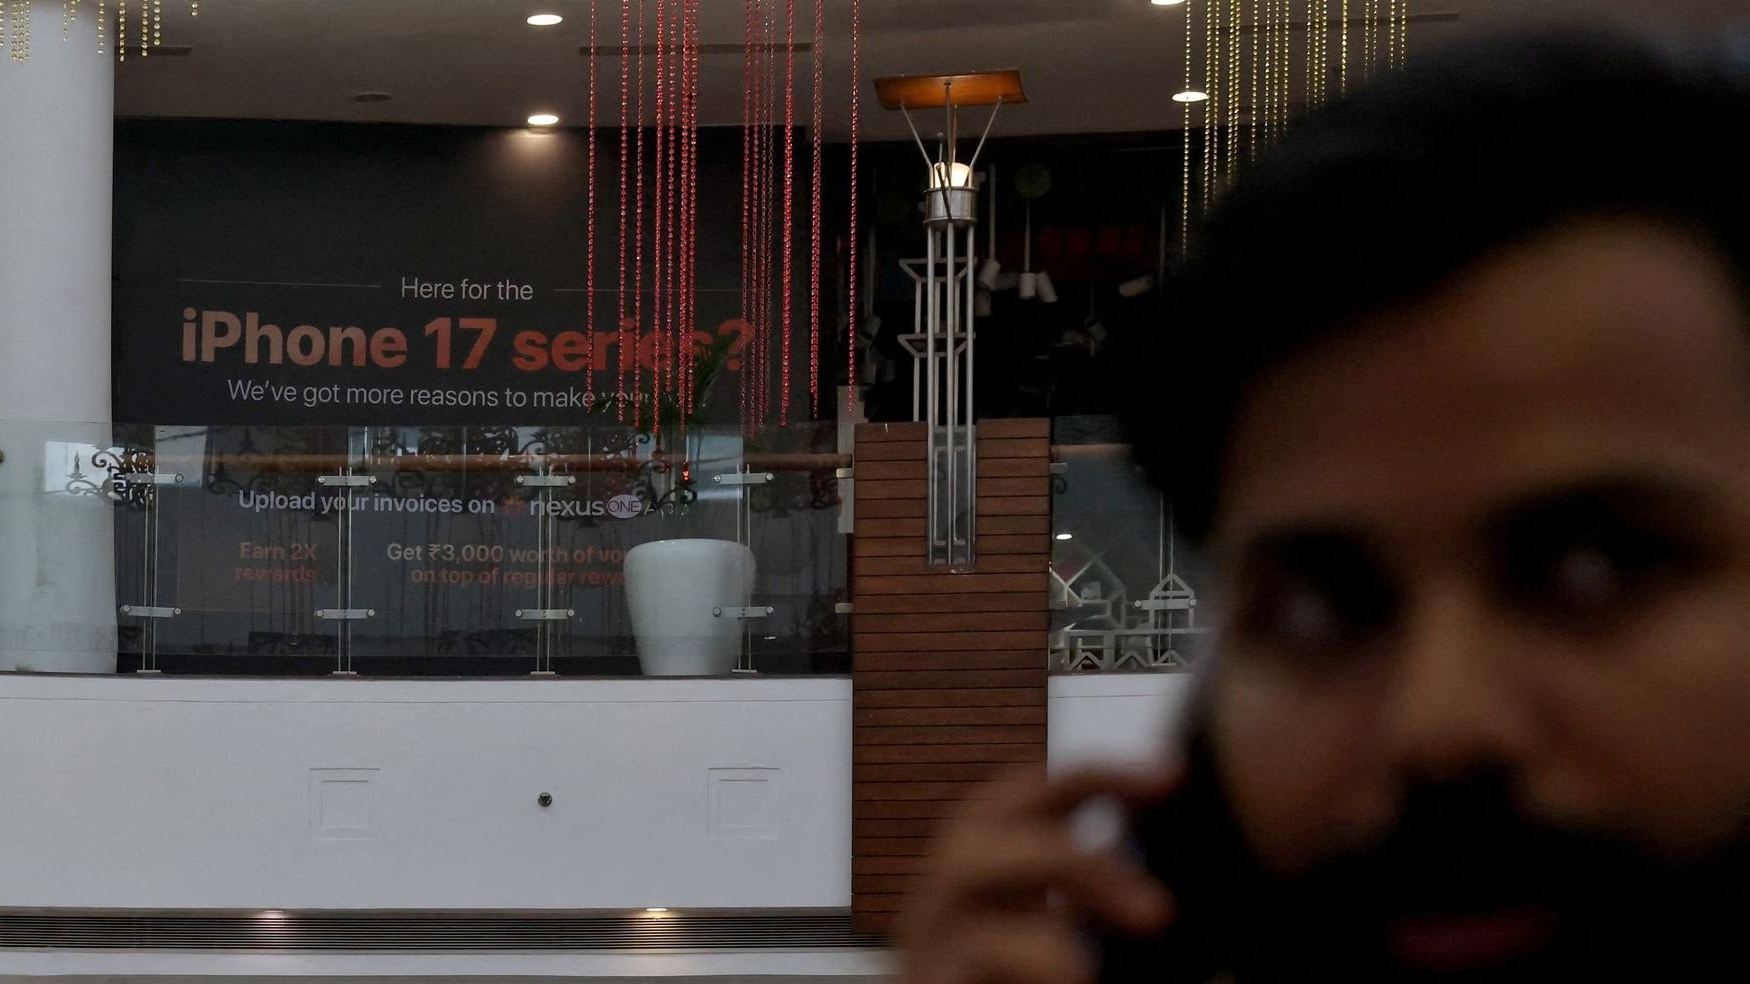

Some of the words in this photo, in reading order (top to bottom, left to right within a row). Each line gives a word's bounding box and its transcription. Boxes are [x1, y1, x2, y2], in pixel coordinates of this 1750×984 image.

[401, 276, 454, 299] Here
[461, 278, 489, 300] for
[496, 279, 534, 301] the
[181, 307, 408, 368] iPhone
[424, 316, 497, 371] 17
[303, 384, 340, 407] got
[347, 386, 403, 405] more
[410, 388, 499, 406] reasons
[505, 387, 526, 408] to
[533, 386, 596, 408] make
[238, 490, 315, 512] Upload
[321, 495, 368, 515] your
[374, 493, 463, 514] invoices
[468, 499, 495, 514] on
[530, 500, 605, 516] nexus
[608, 500, 640, 513] ONE
[238, 541, 284, 561] Earn
[291, 542, 318, 561] 2X
[387, 543, 422, 561] Get
[428, 544, 504, 565] ₹3,000
[509, 545, 569, 564] worth
[573, 545, 595, 564] of
[599, 549, 625, 564] vo
[234, 565, 315, 583] rewards
[411, 568, 437, 583] on
[441, 567, 473, 587] top
[478, 567, 498, 584] of
[504, 568, 574, 588] regular
